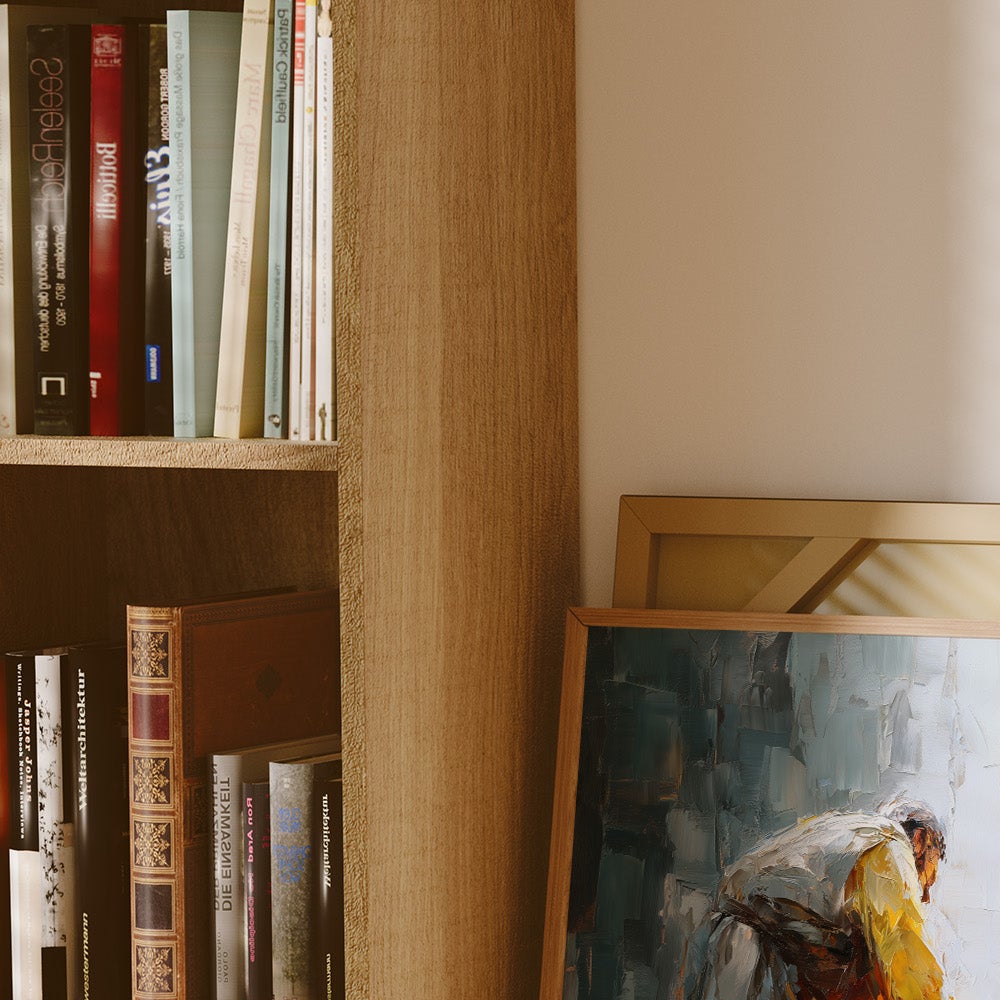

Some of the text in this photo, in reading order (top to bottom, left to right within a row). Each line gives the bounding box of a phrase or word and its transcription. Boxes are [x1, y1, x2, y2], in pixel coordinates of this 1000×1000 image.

[24, 699, 33, 803] Jasper Johns
[76, 669, 87, 811] Weltarchitektur
